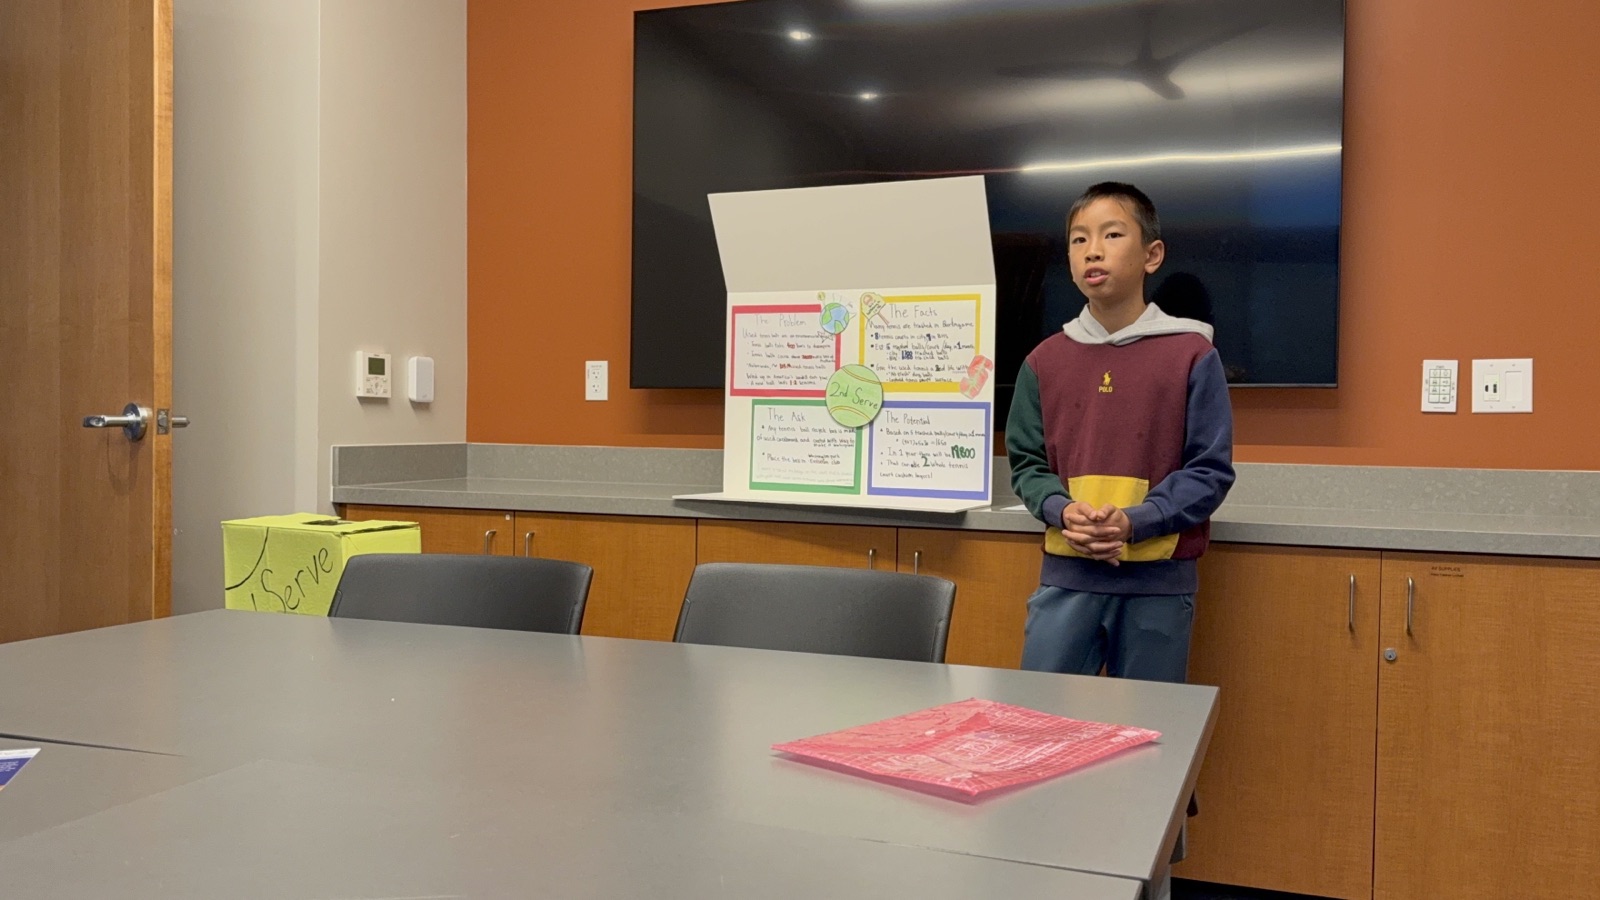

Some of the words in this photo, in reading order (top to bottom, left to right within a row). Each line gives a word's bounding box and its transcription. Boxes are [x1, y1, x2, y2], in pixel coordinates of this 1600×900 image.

[890, 304, 908, 318] The
[914, 305, 937, 318] Facts
[755, 314, 768, 324] The
[780, 314, 806, 327] Problem
[829, 382, 848, 398] 2nd
[852, 387, 878, 410] Serve
[768, 407, 784, 421] The
[792, 412, 806, 421] Ask
[886, 410, 899, 423] The
[904, 414, 930, 425] Potential
[921, 456, 930, 467] 2
[261, 548, 333, 614] Serve
